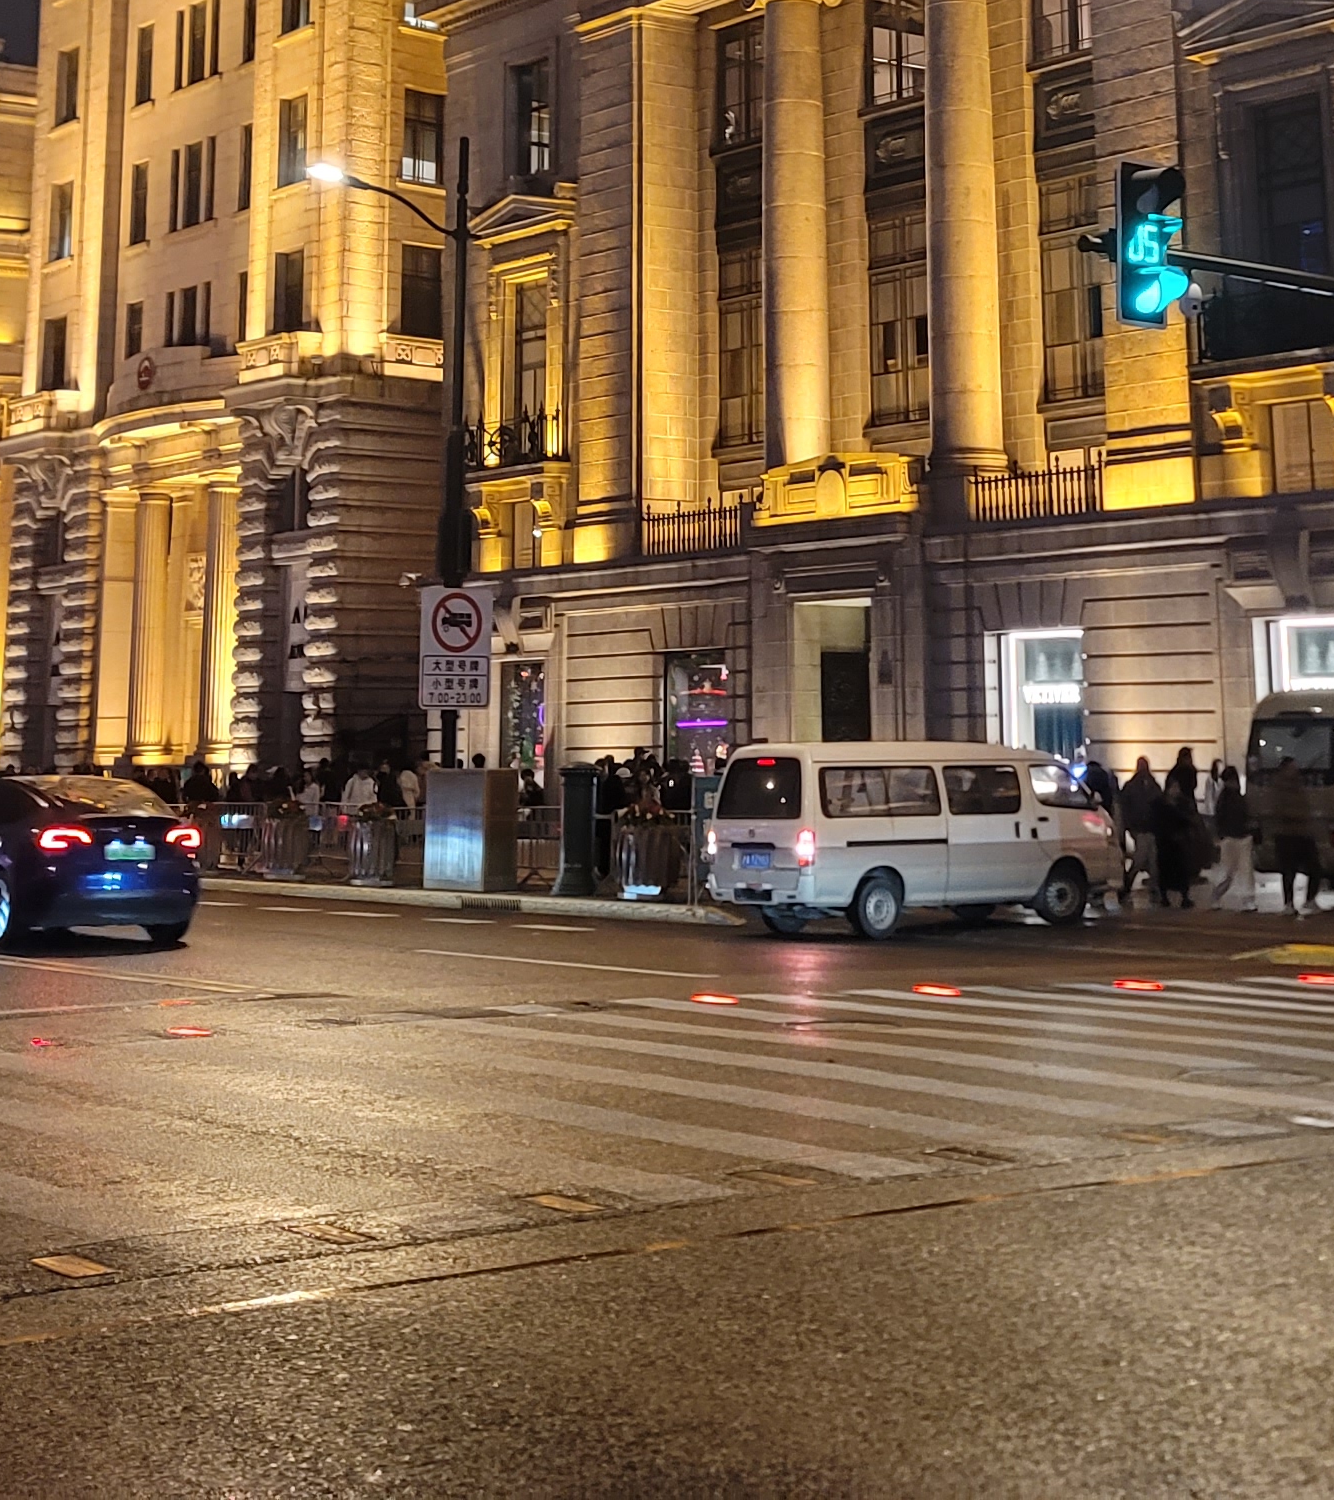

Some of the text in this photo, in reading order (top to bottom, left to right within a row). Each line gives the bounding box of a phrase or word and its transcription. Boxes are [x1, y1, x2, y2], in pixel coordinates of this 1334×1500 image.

[432, 659, 479, 672] 大型号牌
[431, 678, 479, 690] 小型号牌
